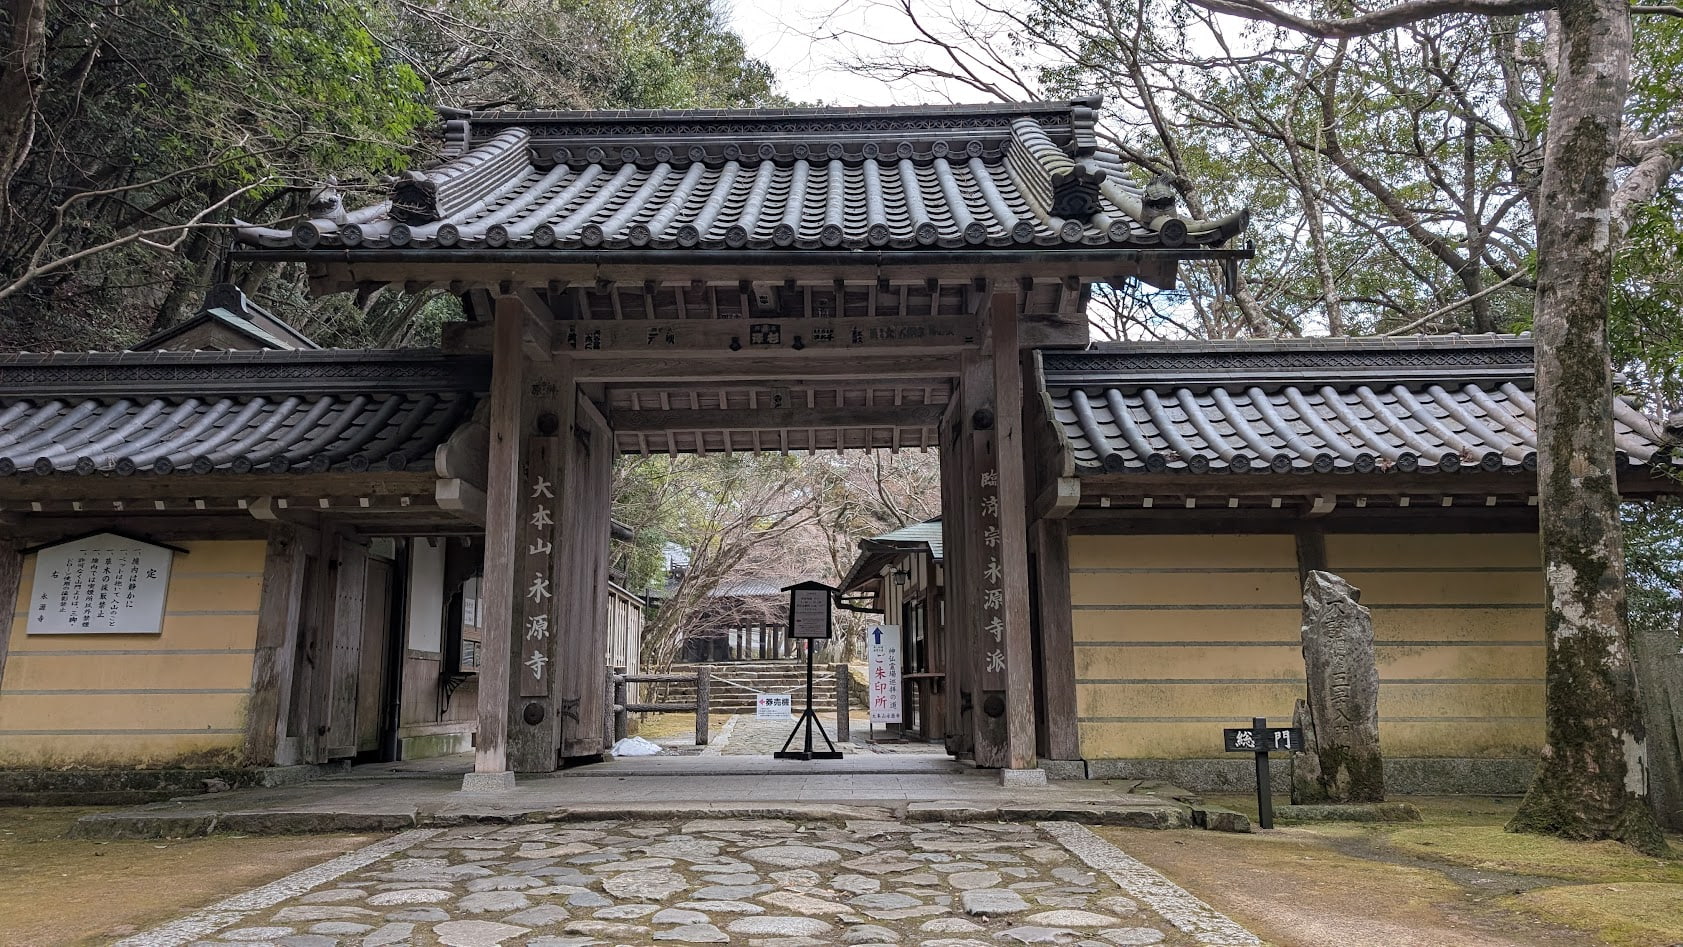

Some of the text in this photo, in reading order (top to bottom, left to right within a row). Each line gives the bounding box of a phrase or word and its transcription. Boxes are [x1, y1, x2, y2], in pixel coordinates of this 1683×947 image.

[50, 570, 59, 579] 右
[145, 569, 158, 580] 定
[524, 476, 554, 680] 大本山永源寺
[980, 470, 1006, 673] 臨済宗永源寺派
[37, 593, 48, 623] 永源寺
[874, 653, 887, 709] ご朱印所
[766, 698, 790, 706] 券売機
[1234, 730, 1291, 749] 総門
